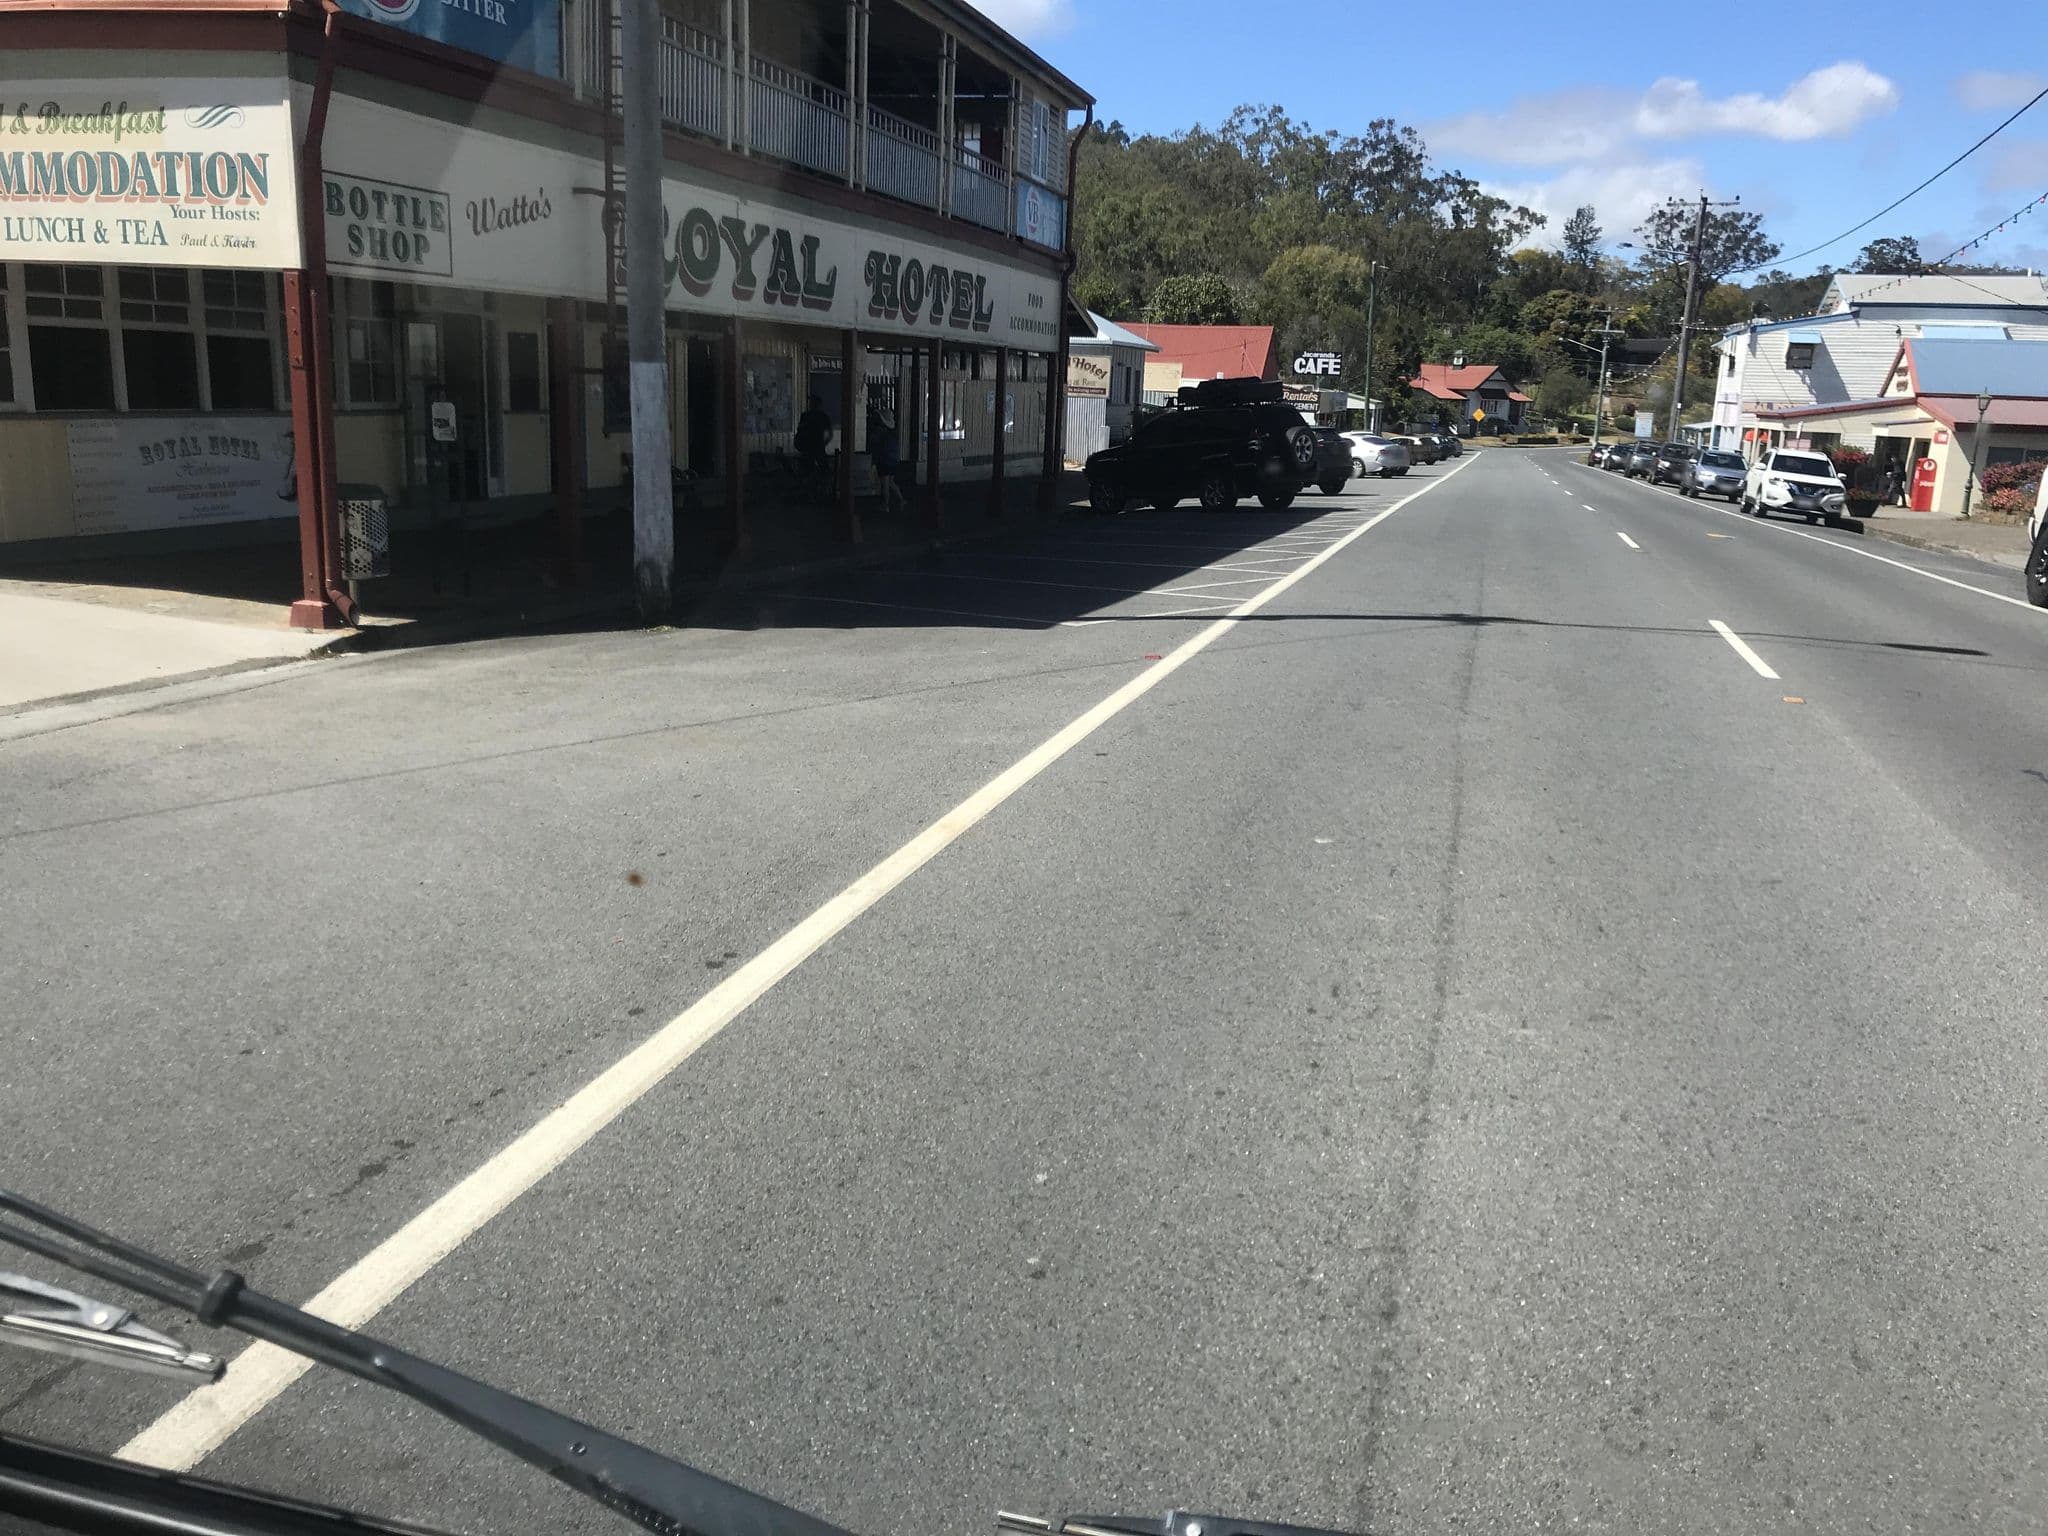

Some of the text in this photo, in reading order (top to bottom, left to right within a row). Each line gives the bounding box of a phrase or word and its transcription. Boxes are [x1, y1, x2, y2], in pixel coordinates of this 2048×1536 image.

[440, 0, 507, 25] TER
[9, 102, 31, 135] &
[36, 101, 168, 143] Breakfast
[169, 204, 260, 221] Your Hosts:
[324, 181, 446, 233] BOTTLE
[465, 186, 552, 236] Watto's
[4, 216, 169, 246] LUNCH & TEA
[179, 232, 208, 247] Paul
[210, 234, 219, 248] &
[347, 223, 430, 265] SHOP
[864, 250, 994, 333] HOTEL
[1028, 292, 1044, 310] FOOD
[1009, 315, 1057, 337] ACCOMMODATION
[1073, 357, 1108, 380] Hotel
[1293, 354, 1341, 375] CAFÉ
[1282, 391, 1319, 402] Rentals
[140, 435, 261, 466] ROYAL HOTEL
